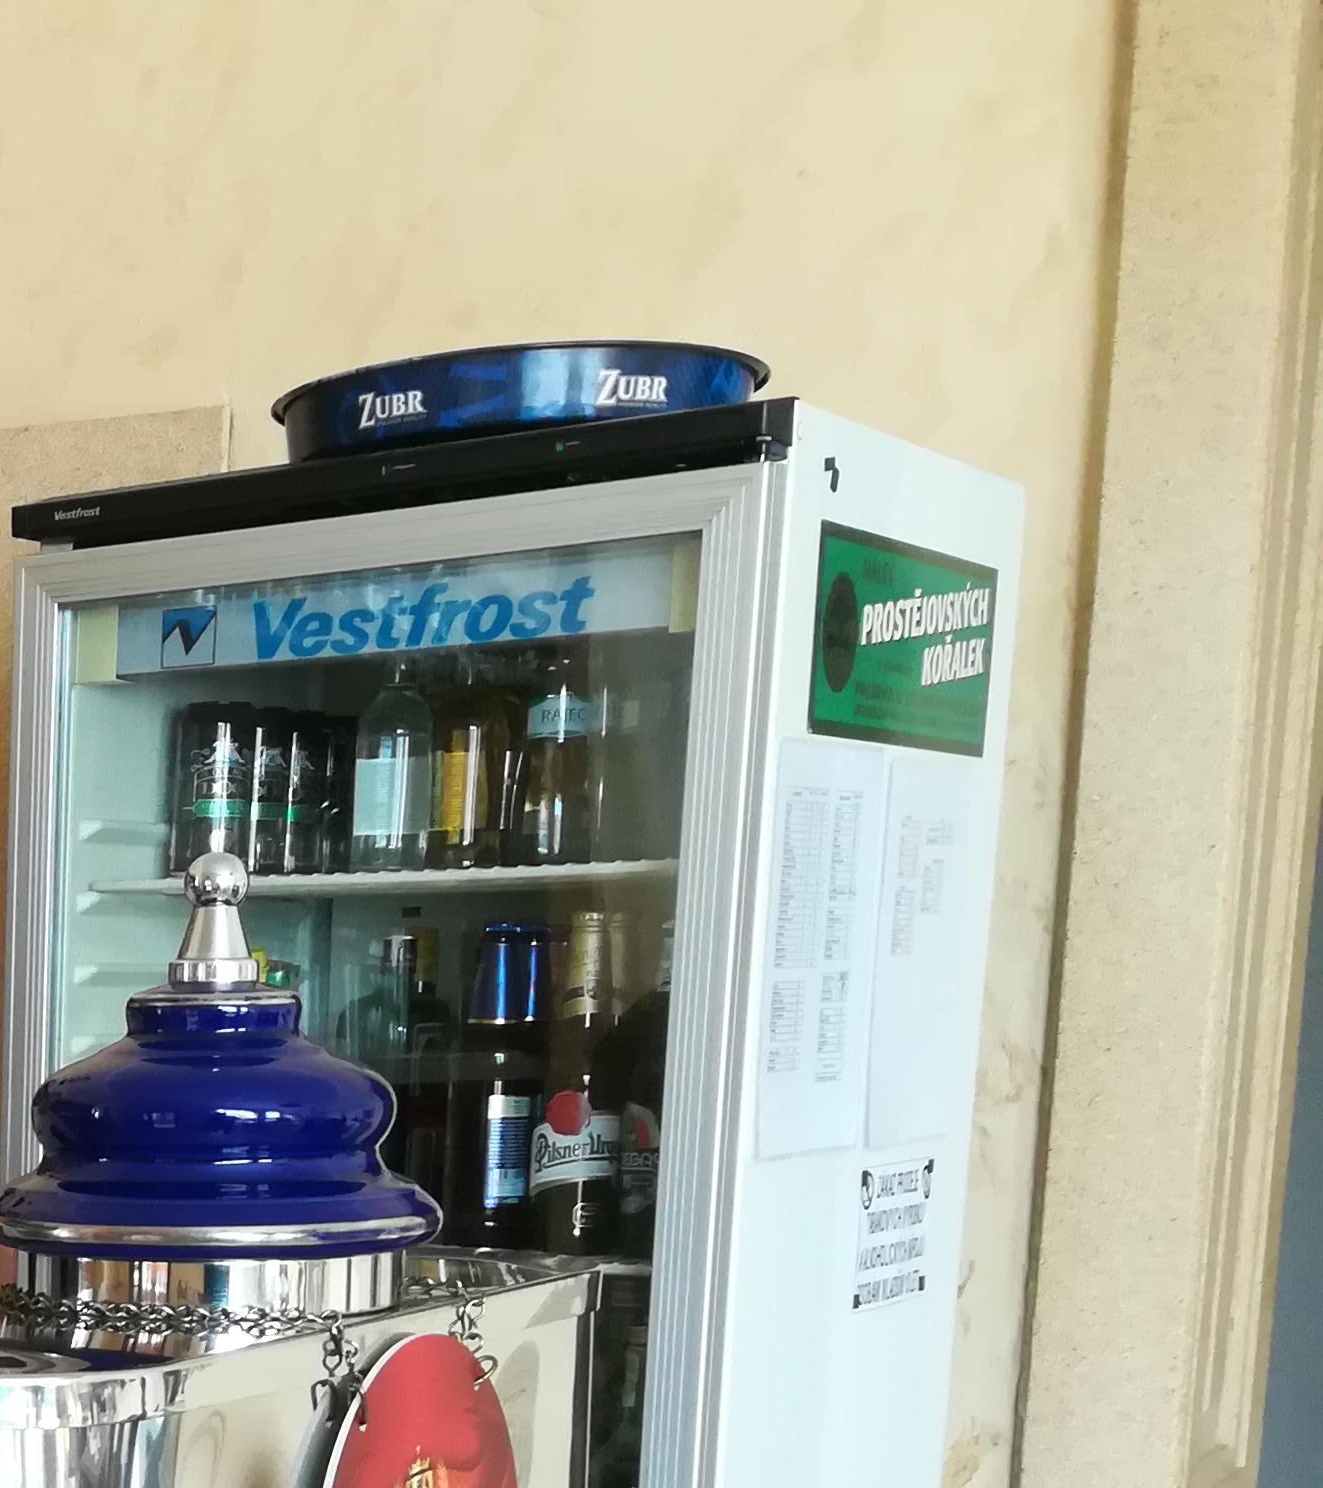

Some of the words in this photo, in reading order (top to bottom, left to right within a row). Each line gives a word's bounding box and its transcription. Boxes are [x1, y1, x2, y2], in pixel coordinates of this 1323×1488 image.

[358, 390, 428, 430] ZUBR
[594, 368, 669, 408] ZUBR
[54, 506, 101, 522] Vestfrost
[253, 576, 595, 662] Vestfrost
[860, 581, 991, 647] PROSTĚJOVSKÝCH
[921, 634, 987, 688] KOŘALEK
